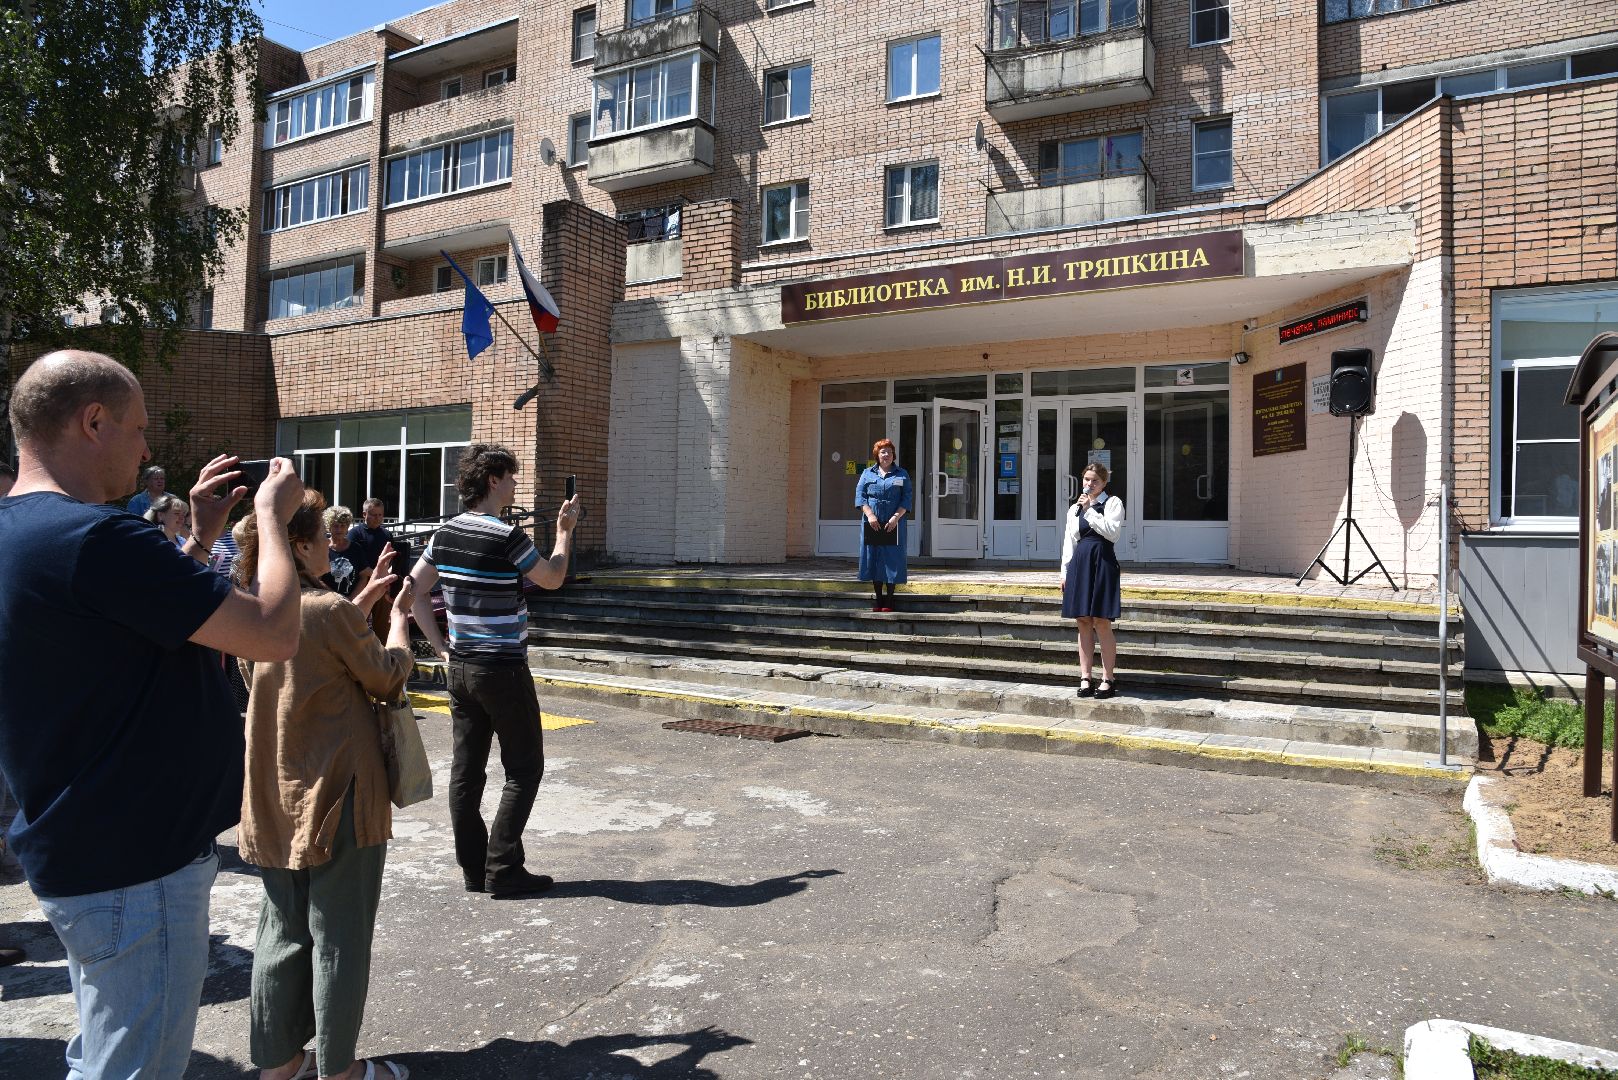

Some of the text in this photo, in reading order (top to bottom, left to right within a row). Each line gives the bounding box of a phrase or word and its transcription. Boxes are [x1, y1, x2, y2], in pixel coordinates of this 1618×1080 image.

[804, 248, 1210, 310] БИБЛИОТЕКА им. Н.И. ТРЯПКИНА
